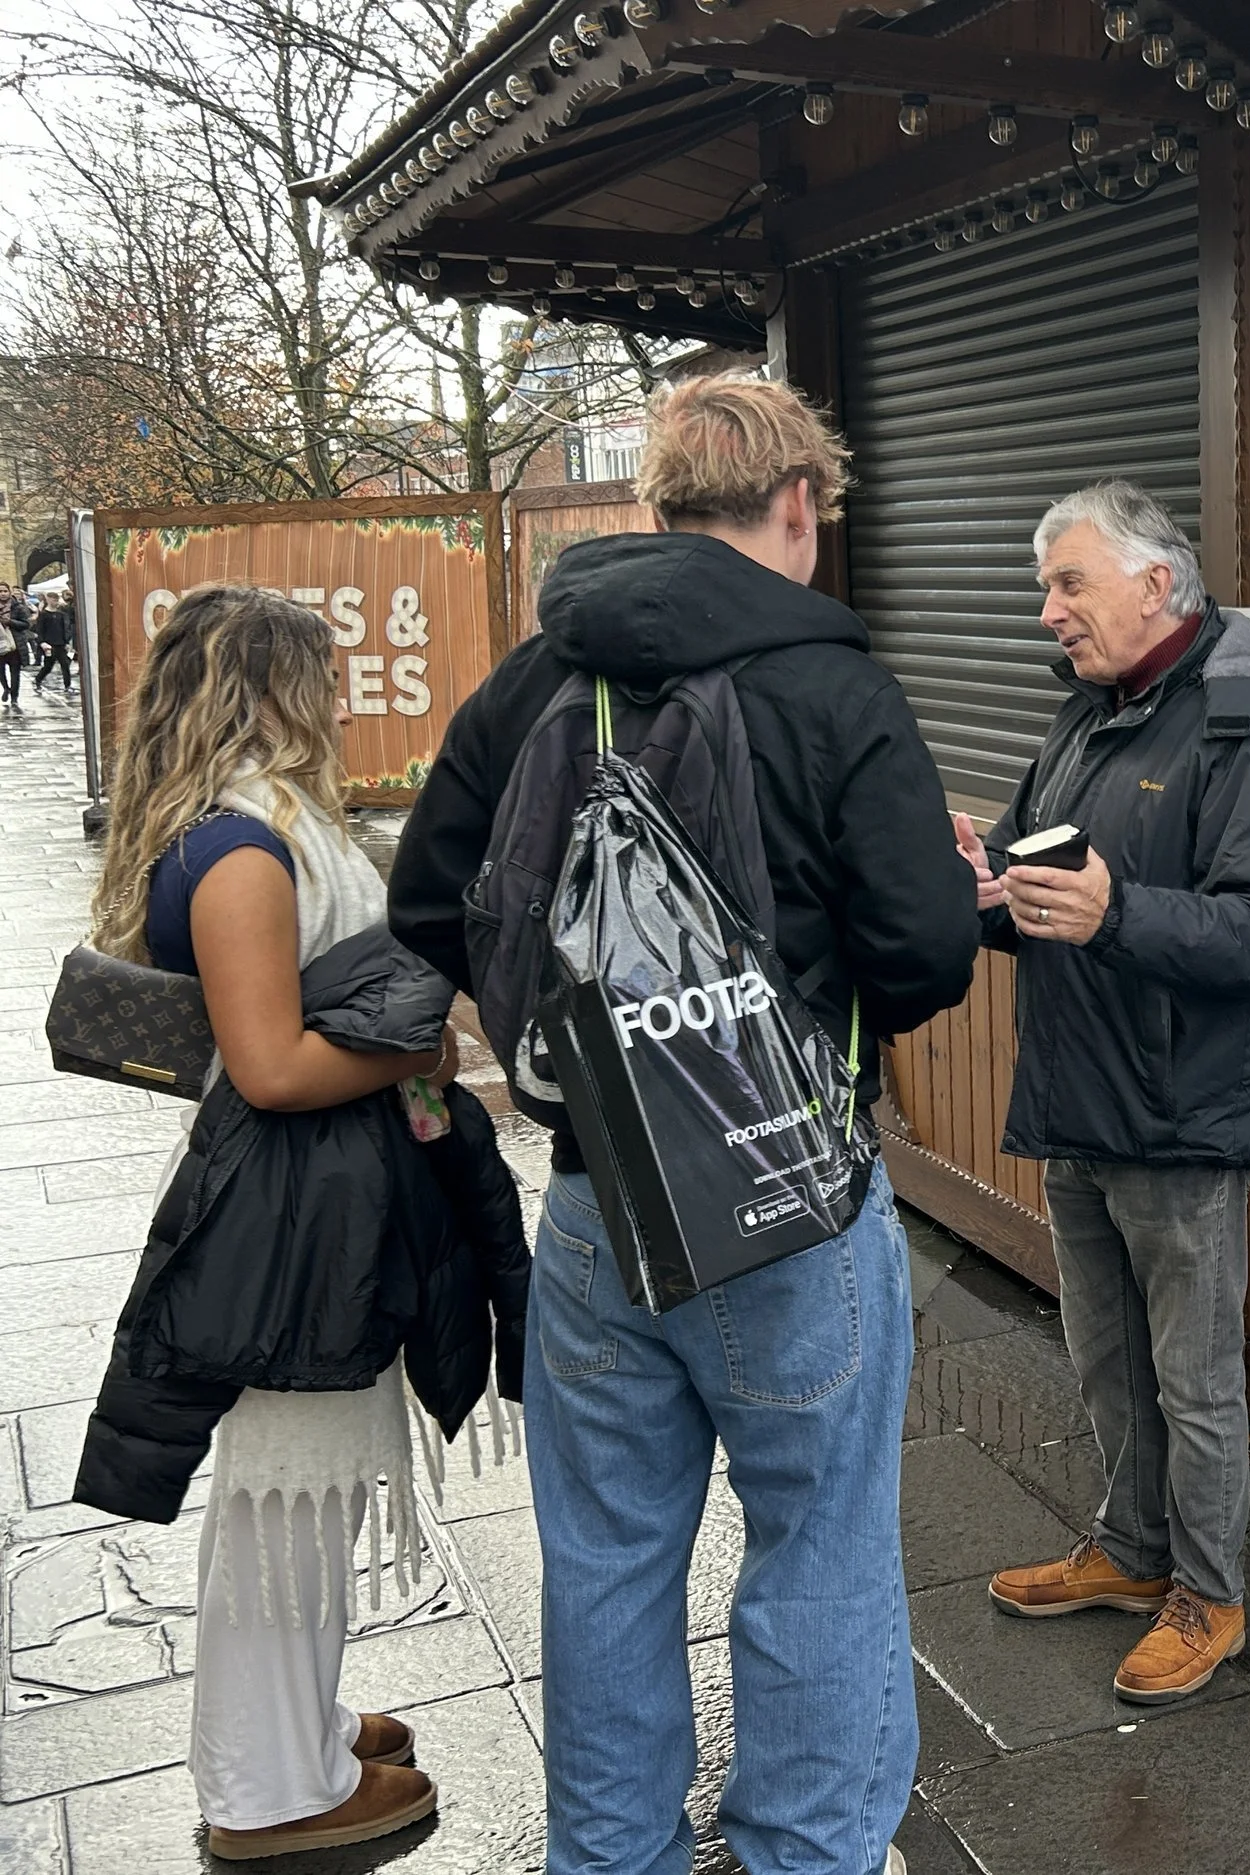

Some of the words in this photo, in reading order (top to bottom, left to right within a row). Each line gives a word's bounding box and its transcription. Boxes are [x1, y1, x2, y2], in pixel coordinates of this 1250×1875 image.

[386, 585, 430, 648] &
[759, 1208, 778, 1223] App
[777, 1200, 801, 1216] Store
